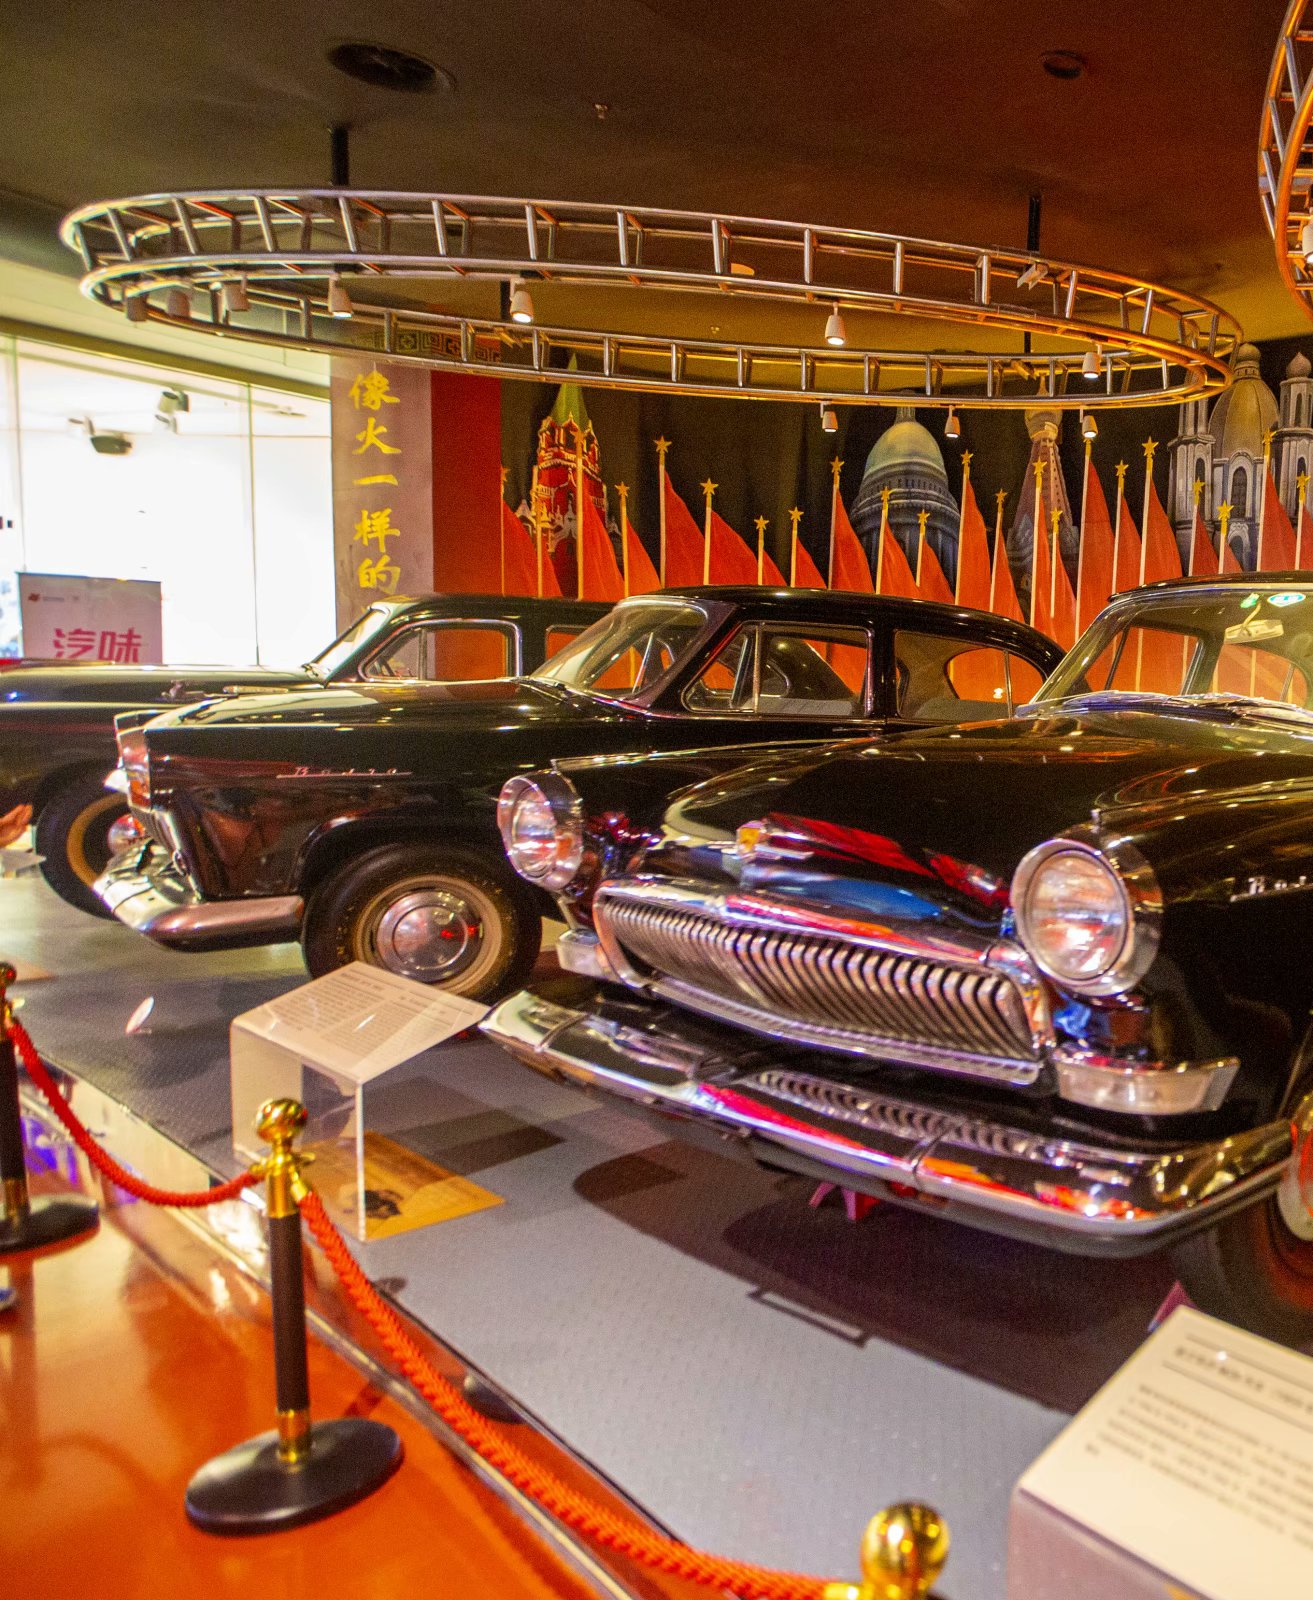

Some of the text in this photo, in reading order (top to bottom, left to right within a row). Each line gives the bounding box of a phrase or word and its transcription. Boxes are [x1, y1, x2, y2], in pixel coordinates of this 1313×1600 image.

[348, 368, 402, 596] 像火一样的
